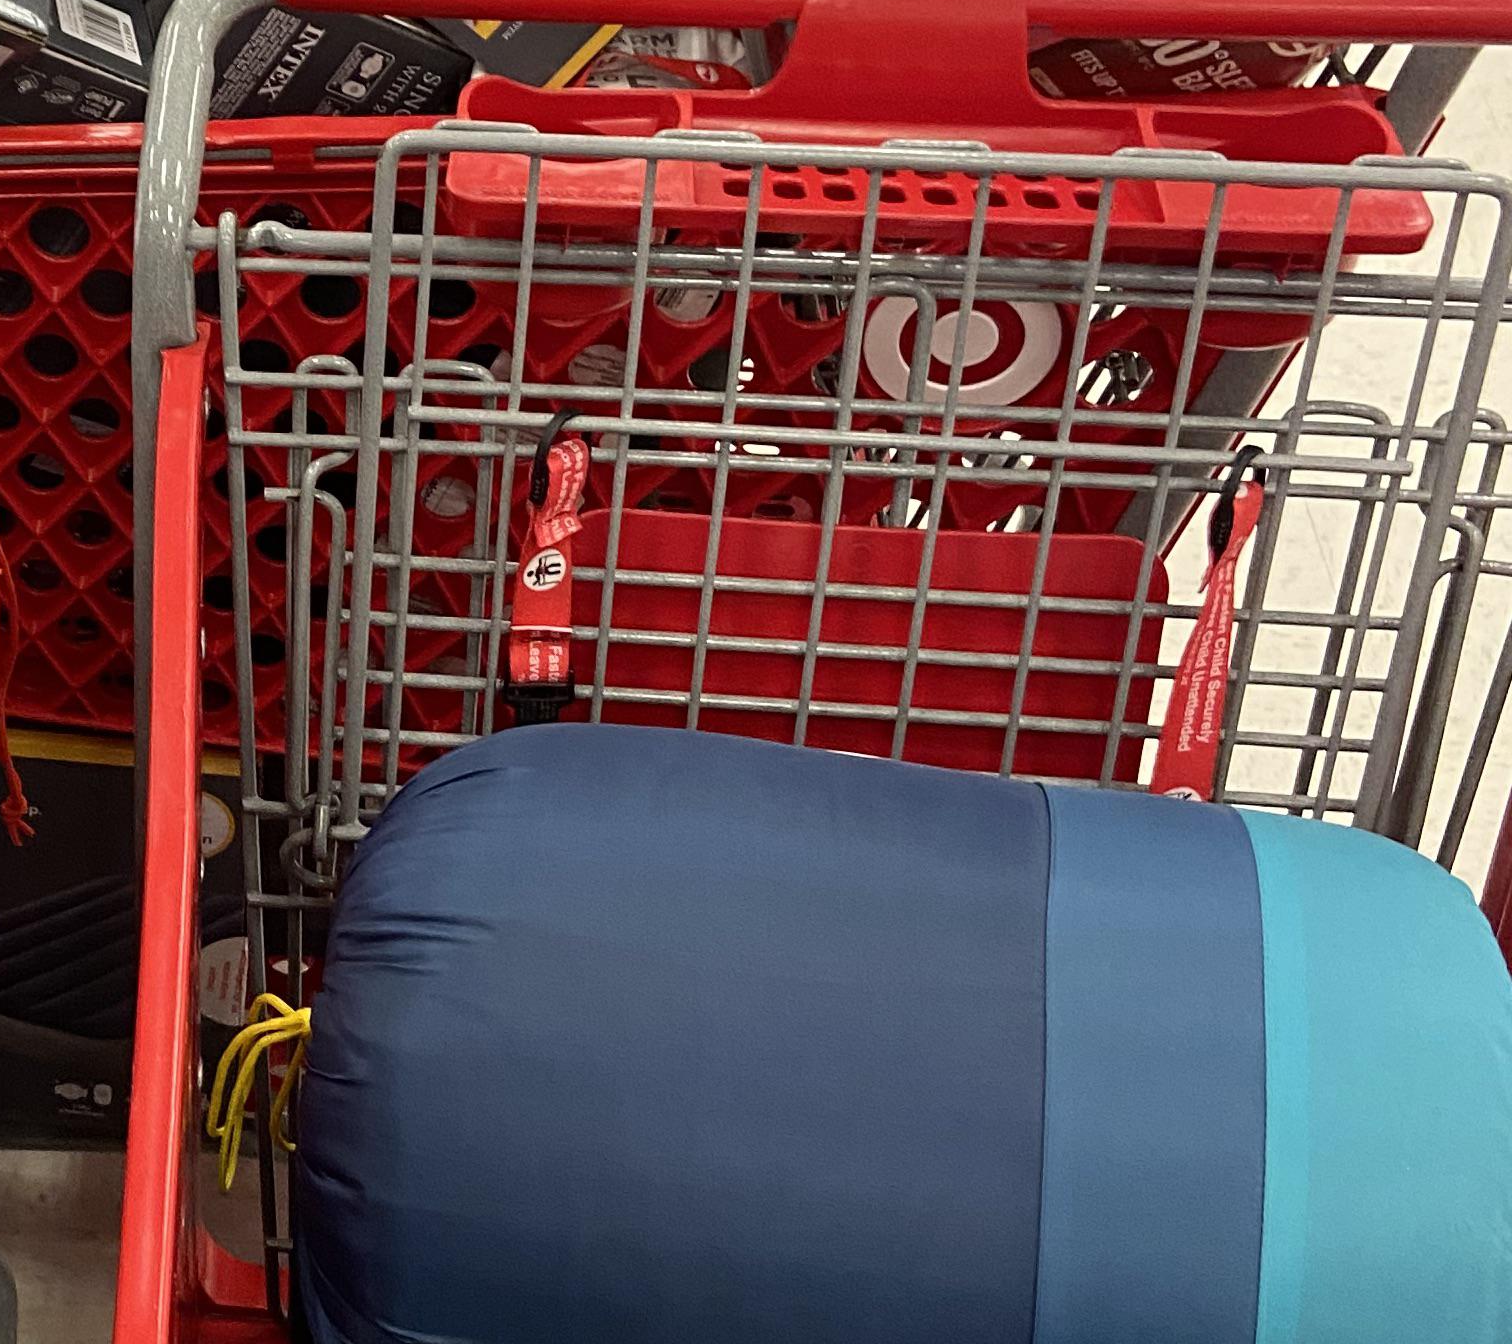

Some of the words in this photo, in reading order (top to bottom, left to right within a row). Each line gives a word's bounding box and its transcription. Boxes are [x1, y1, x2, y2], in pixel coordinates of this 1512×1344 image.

[254, 18, 327, 104] INTEX
[1194, 629, 1214, 670] Child
[1208, 635, 1228, 677] Child
[1175, 668, 1206, 754] Unattended
[1195, 678, 1222, 744] Securely
